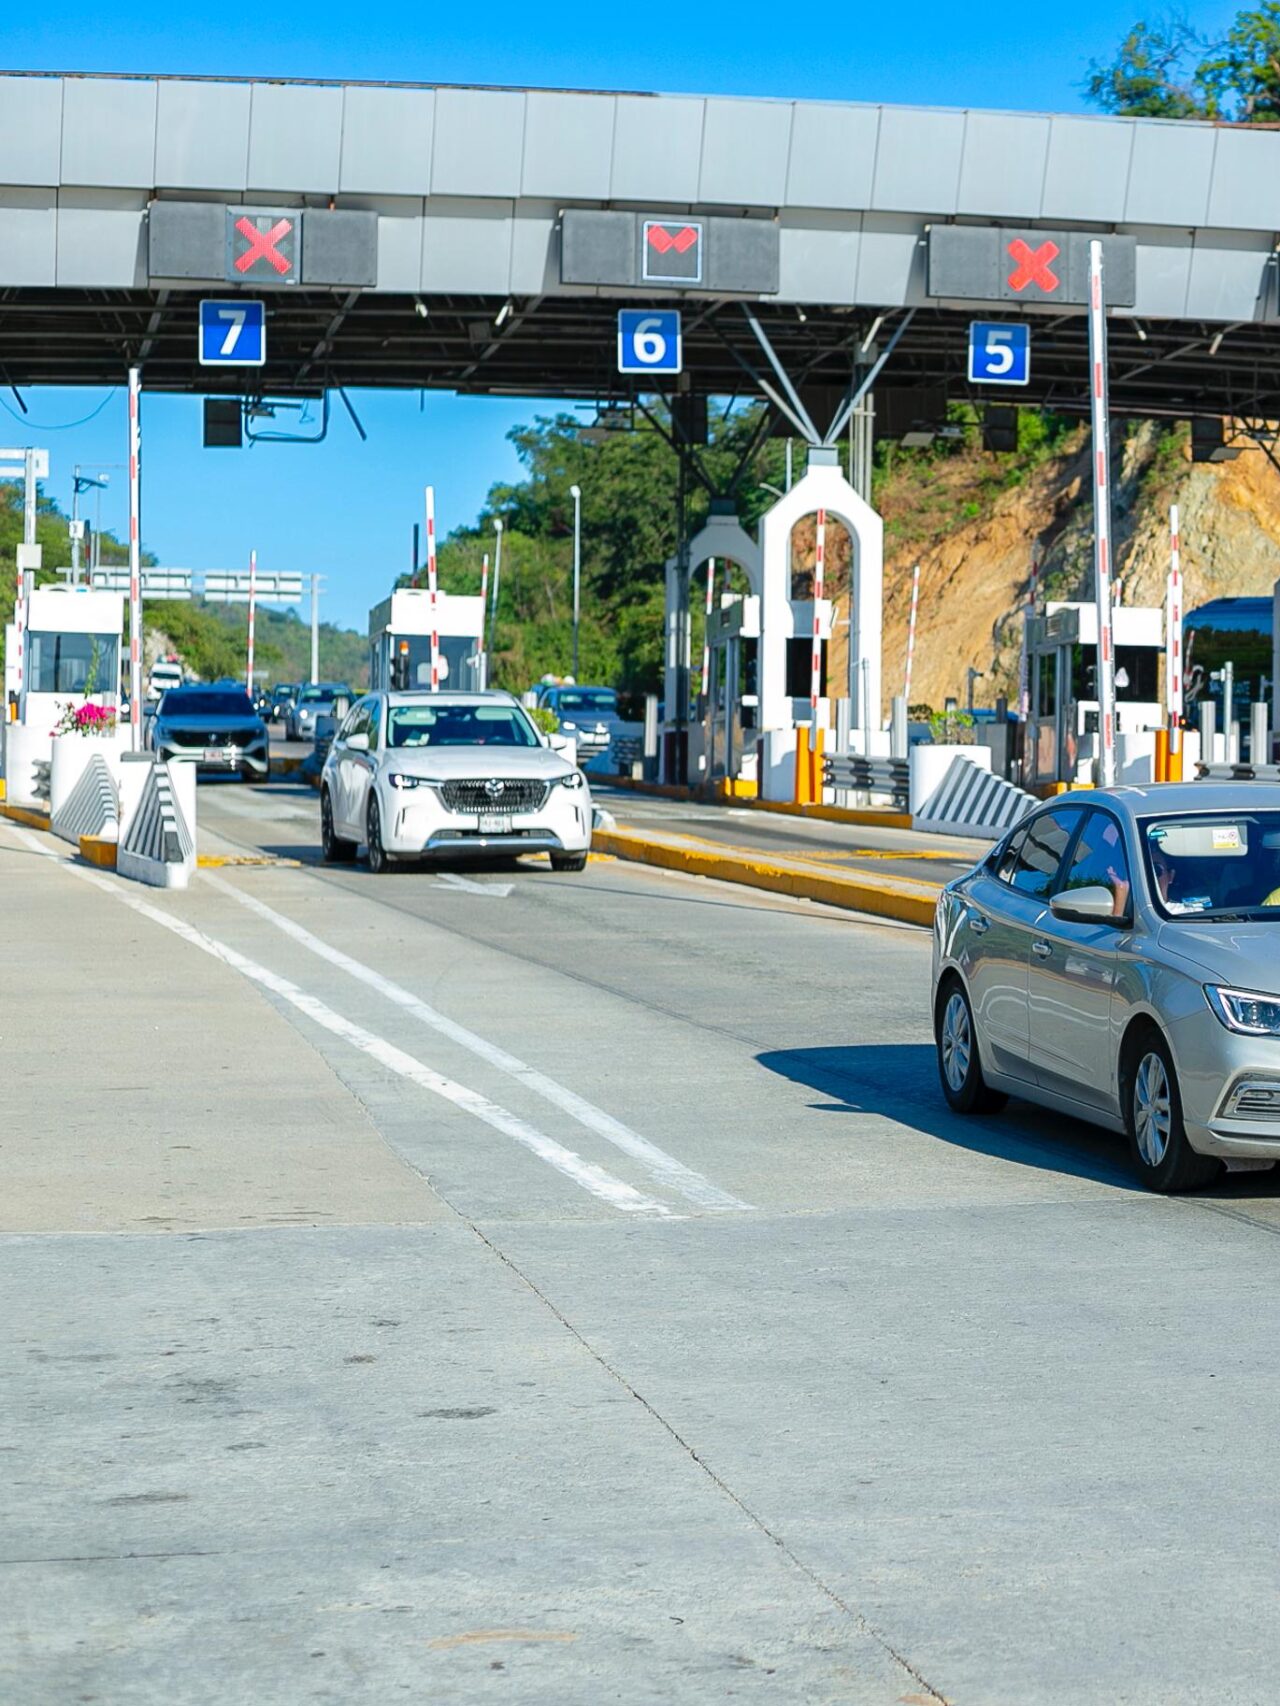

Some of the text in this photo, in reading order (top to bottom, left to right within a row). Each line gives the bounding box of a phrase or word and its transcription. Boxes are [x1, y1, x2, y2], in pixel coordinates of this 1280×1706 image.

[218, 310, 247, 355] 7
[633, 318, 667, 364] 6
[984, 331, 1014, 375] 5
